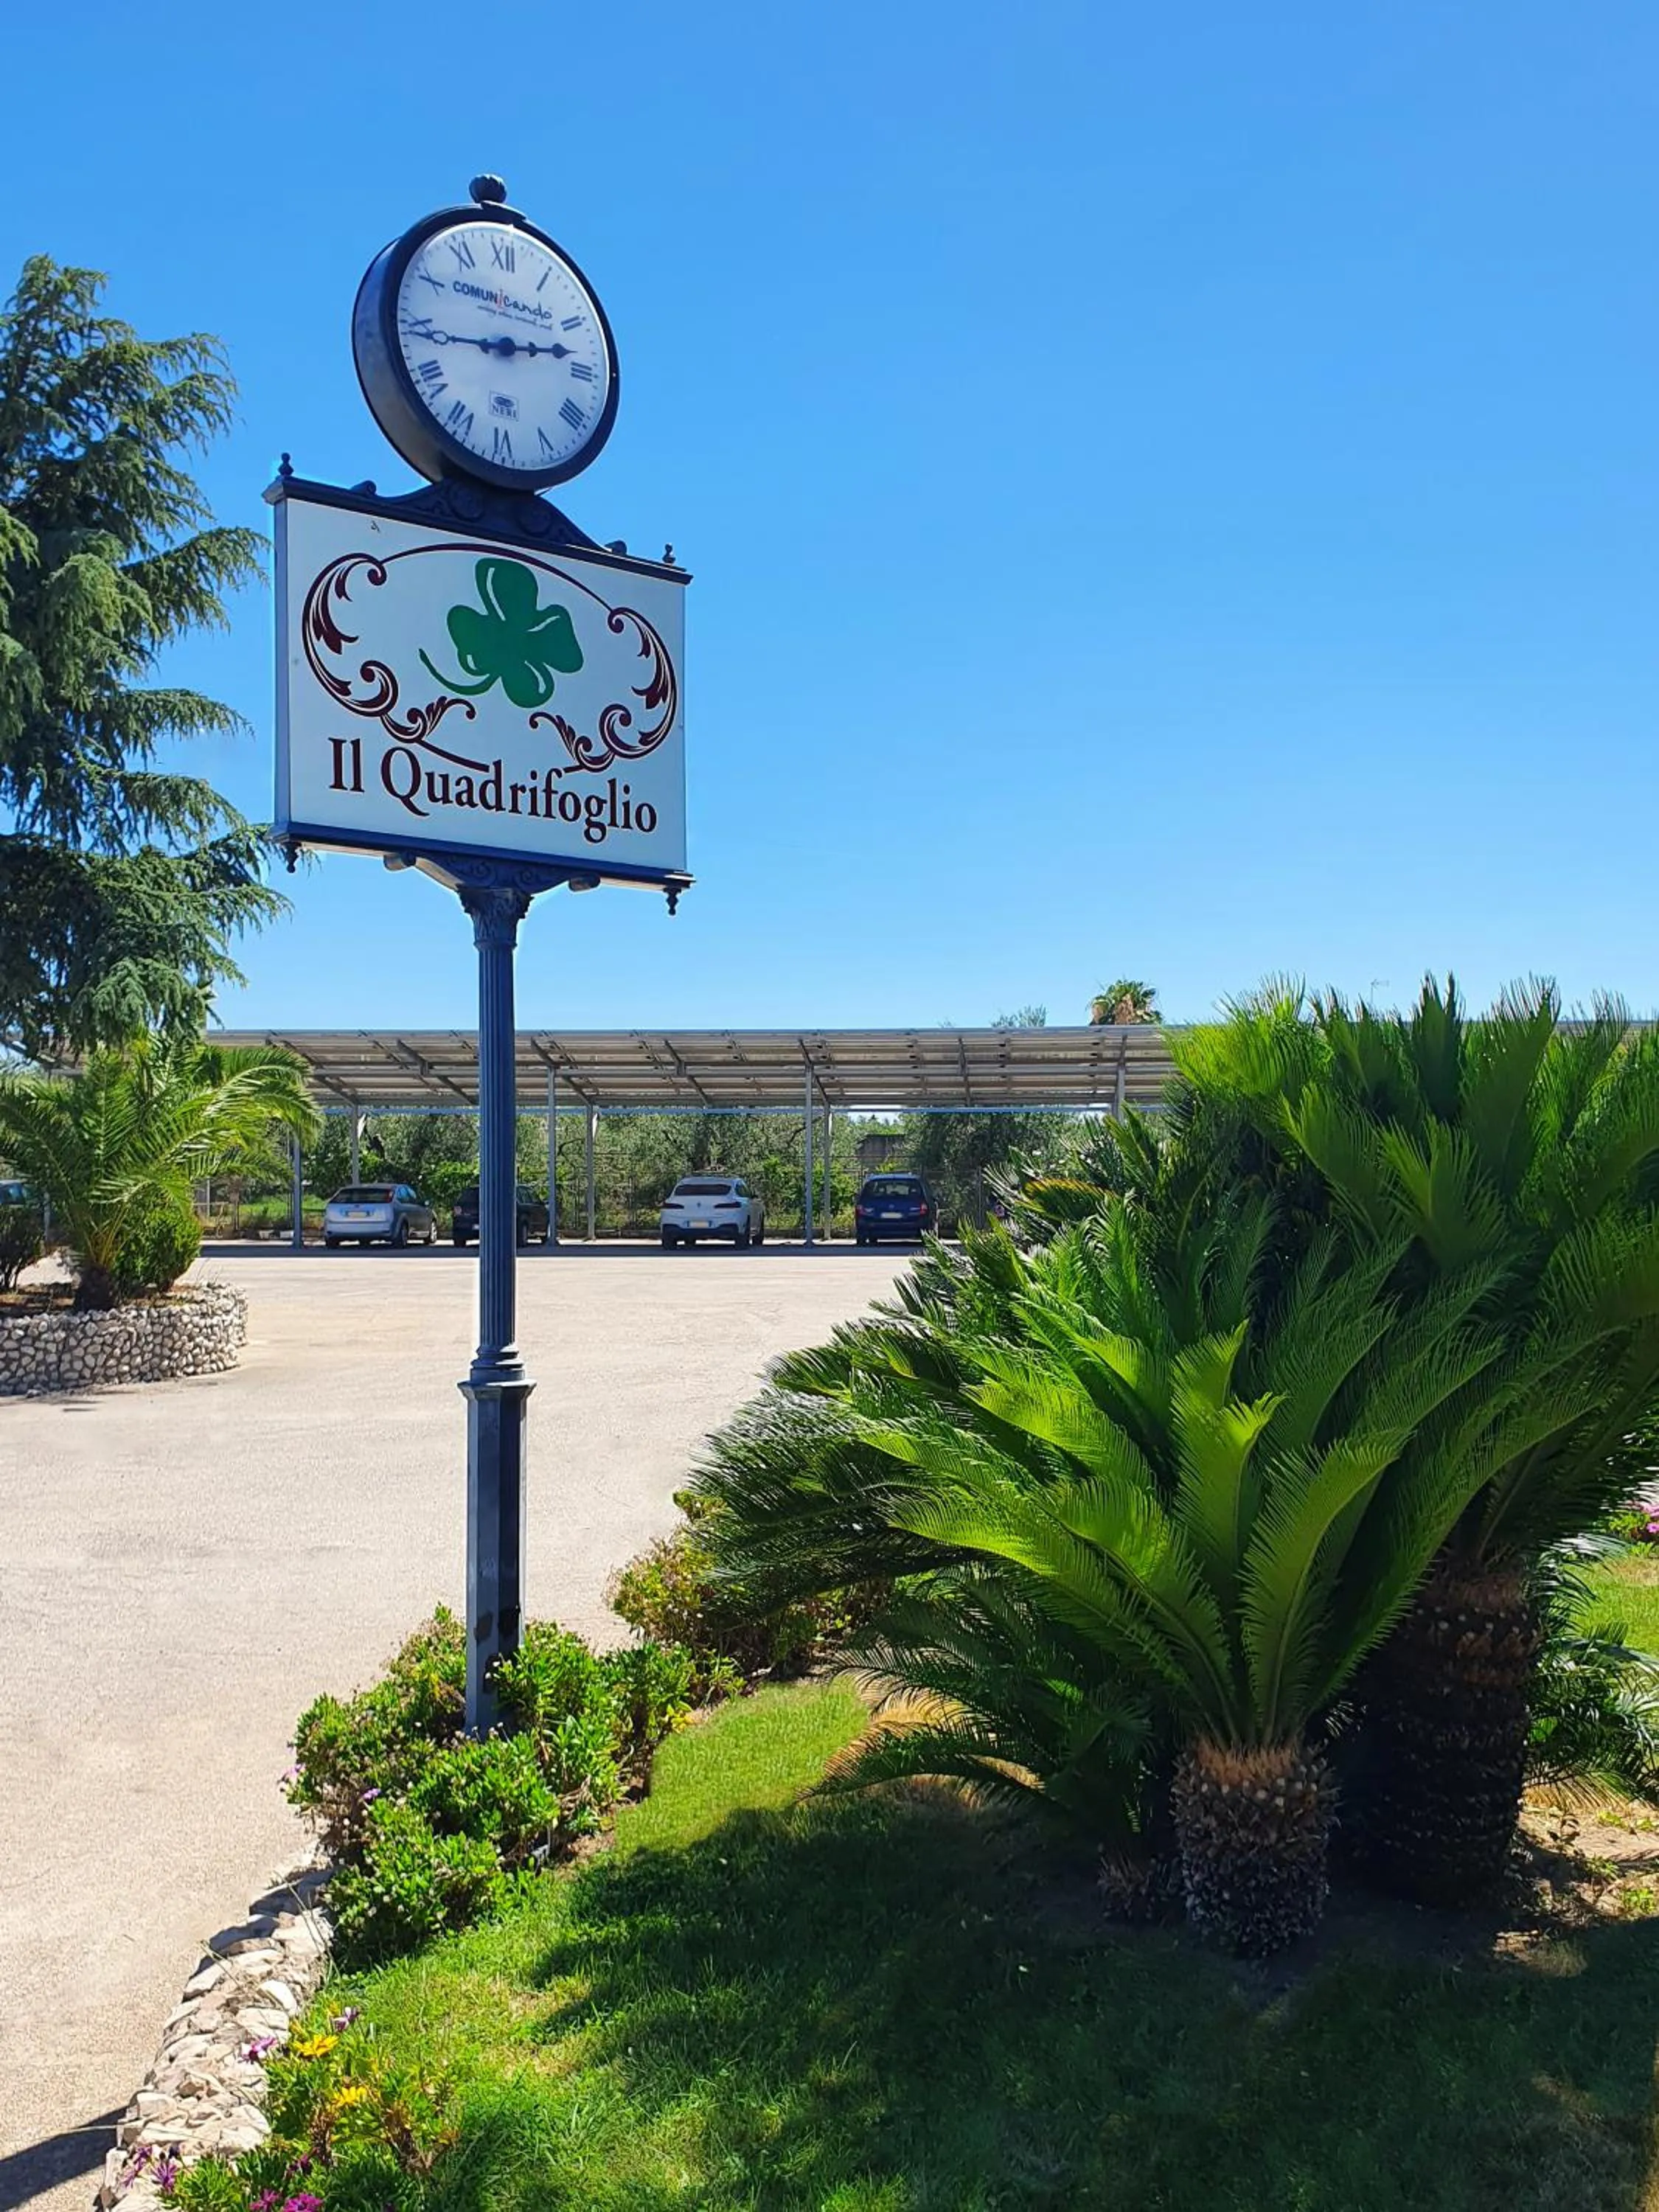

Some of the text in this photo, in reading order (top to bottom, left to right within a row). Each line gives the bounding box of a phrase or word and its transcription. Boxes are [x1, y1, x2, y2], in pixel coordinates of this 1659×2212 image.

[449, 241, 476, 272] XI
[490, 241, 515, 274] XII
[418, 268, 445, 296] X
[561, 315, 582, 332] II
[417, 359, 448, 399] VIII
[571, 361, 593, 383] III
[448, 400, 474, 437] VII
[493, 426, 512, 458] VI
[538, 426, 554, 455] V
[328, 737, 658, 844] Il Quadrifoglio
